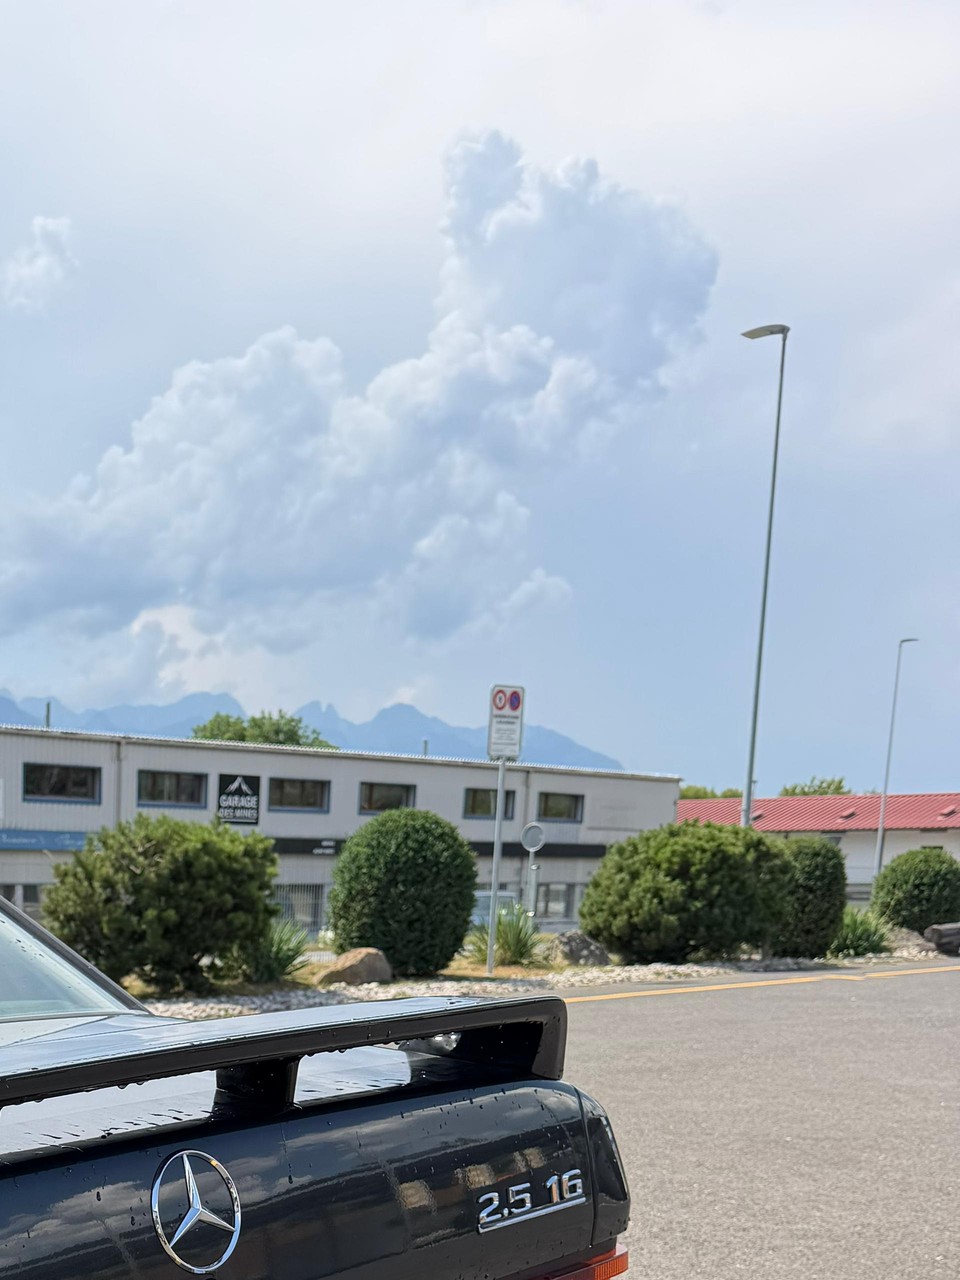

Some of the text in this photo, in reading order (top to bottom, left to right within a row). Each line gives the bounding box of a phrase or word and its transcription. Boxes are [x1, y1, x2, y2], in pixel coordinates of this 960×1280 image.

[220, 794, 258, 808] GARAGE
[478, 1169, 584, 1224] 2.5 16
